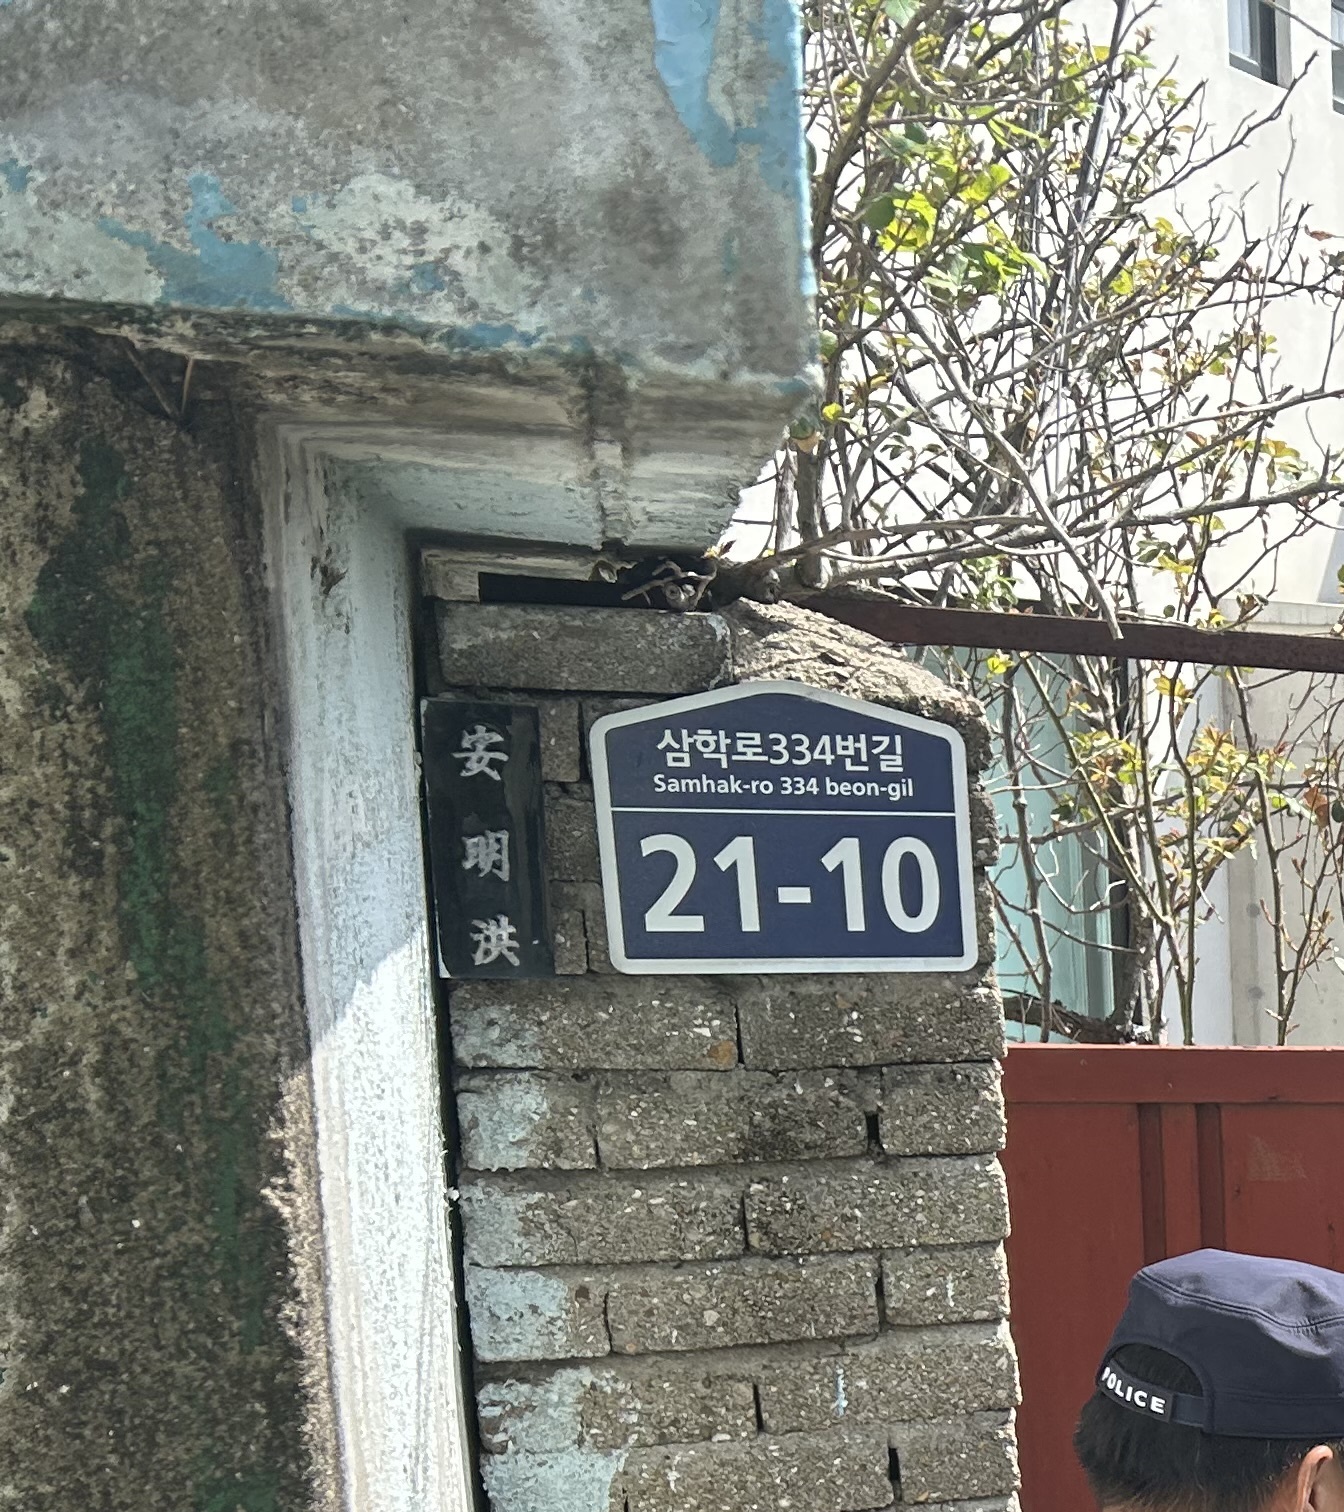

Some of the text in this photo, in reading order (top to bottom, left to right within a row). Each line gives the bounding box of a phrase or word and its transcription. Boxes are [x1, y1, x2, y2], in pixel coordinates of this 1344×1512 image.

[656, 728, 905, 774] 삼학로334번길
[653, 774, 914, 801] Samhak-ro 334 beon-gil
[640, 833, 941, 934] 21-10
[1101, 1366, 1166, 1415] POLICE
